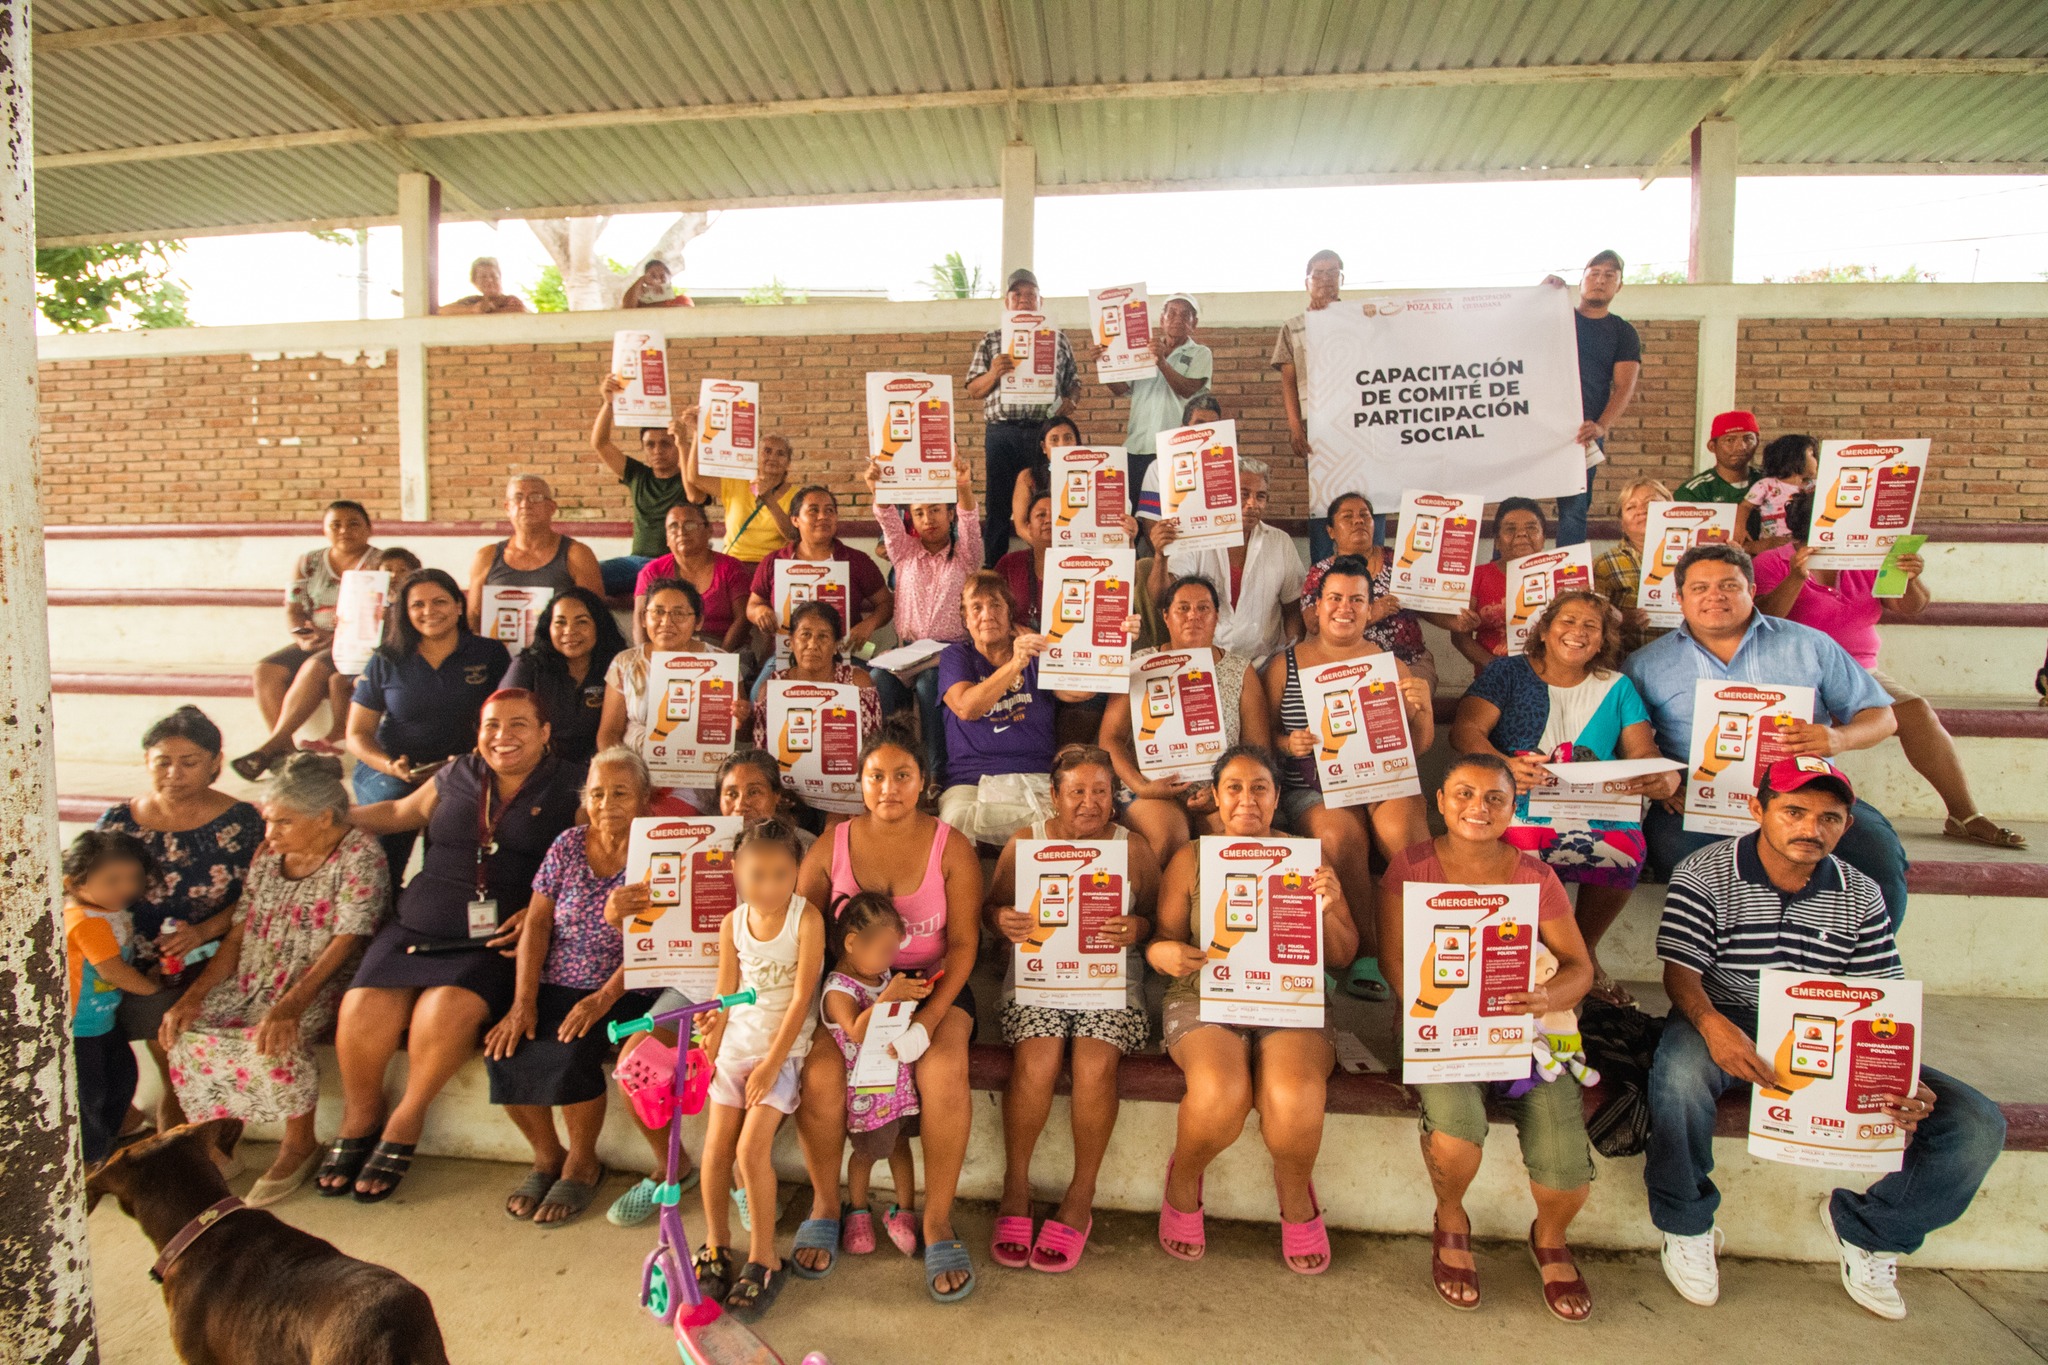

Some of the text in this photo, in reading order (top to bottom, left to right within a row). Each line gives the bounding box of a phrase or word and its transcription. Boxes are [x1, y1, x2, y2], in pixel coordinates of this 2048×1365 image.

[1463, 293, 1511, 302] PARTICIPACIÓN
[1463, 302, 1501, 310] CIUDADANA
[1356, 357, 1524, 386] CAPACITACIÓN
[1362, 380, 1520, 406] DE COMITÉ DE
[1354, 398, 1529, 428] PARTICIPACIÓN
[1401, 424, 1484, 444] SOCIAL
[1820, 532, 1834, 541] C4
[1521, 553, 1567, 569] EMERGENCIAS
[1648, 590, 1661, 599] C4
[1049, 648, 1063, 659] C4
[1317, 665, 1369, 683] EMERGENCIAS
[1718, 692, 1782, 701] EMERGENCIAS
[1146, 744, 1159, 755] C4
[1393, 759, 1408, 767] 089
[1328, 764, 1343, 776] C4
[1699, 786, 1715, 799] C4
[650, 827, 711, 837] EMERGENCIAS
[1037, 850, 1097, 859] EMERGENCIAS
[1223, 849, 1287, 858] EMERGENCIAS
[1431, 898, 1504, 907] EMERGENCIAS
[637, 938, 654, 951] C4
[1027, 958, 1043, 971] C4
[1100, 965, 1116, 974] 089
[1213, 965, 1231, 980] C4
[1245, 970, 1270, 980] 911
[1294, 977, 1312, 987] 089
[1791, 987, 1878, 1000] EMERGENCIAS
[1419, 1025, 1438, 1040] C4
[1453, 1027, 1478, 1036] 911
[1503, 1029, 1522, 1039] 089
[1856, 1042, 1909, 1050] ACOMPAÑAMIENTO
[1768, 1106, 1792, 1122] C4
[1812, 1116, 1845, 1128] 911
[1873, 1124, 1894, 1135] 089
